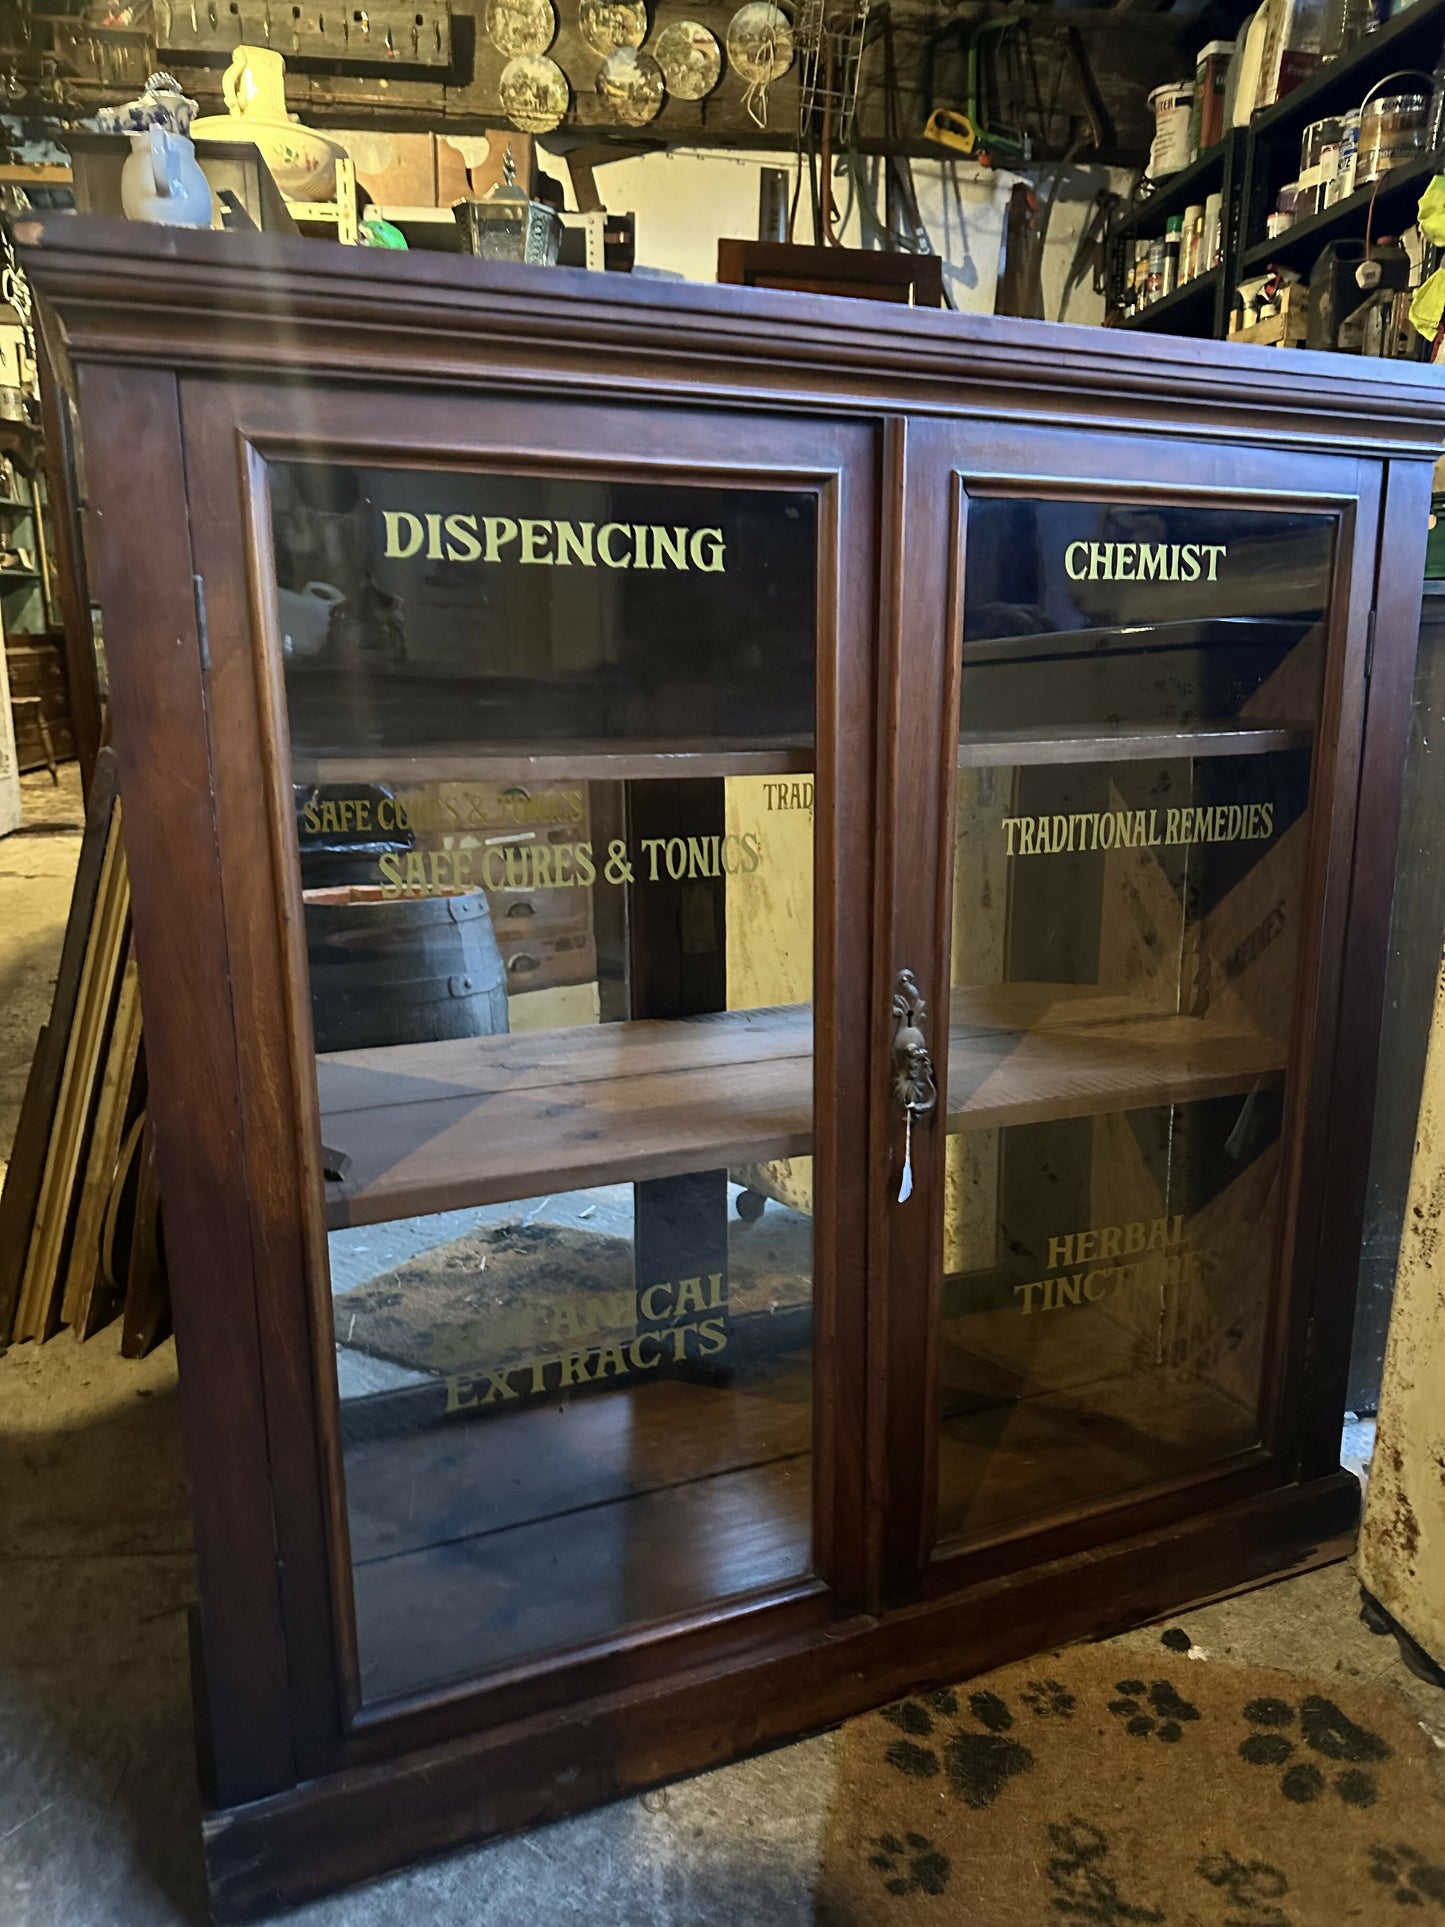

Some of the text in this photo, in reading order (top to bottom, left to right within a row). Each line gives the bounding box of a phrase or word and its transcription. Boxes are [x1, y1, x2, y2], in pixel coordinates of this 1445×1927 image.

[384, 511, 726, 573] DISPENCING
[1064, 540, 1227, 582] CHEMIST
[303, 799, 371, 833] SAFE
[377, 797, 460, 831] CUS
[1002, 802, 1274, 856] TRADITIONAL REMEDIES
[378, 832, 760, 899] SAFE CURES & TONICS
[1046, 1213, 1192, 1270] HERBAL
[1013, 1248, 1219, 1316] TINCTRES
[445, 1316, 729, 1413] EXTRACTS
